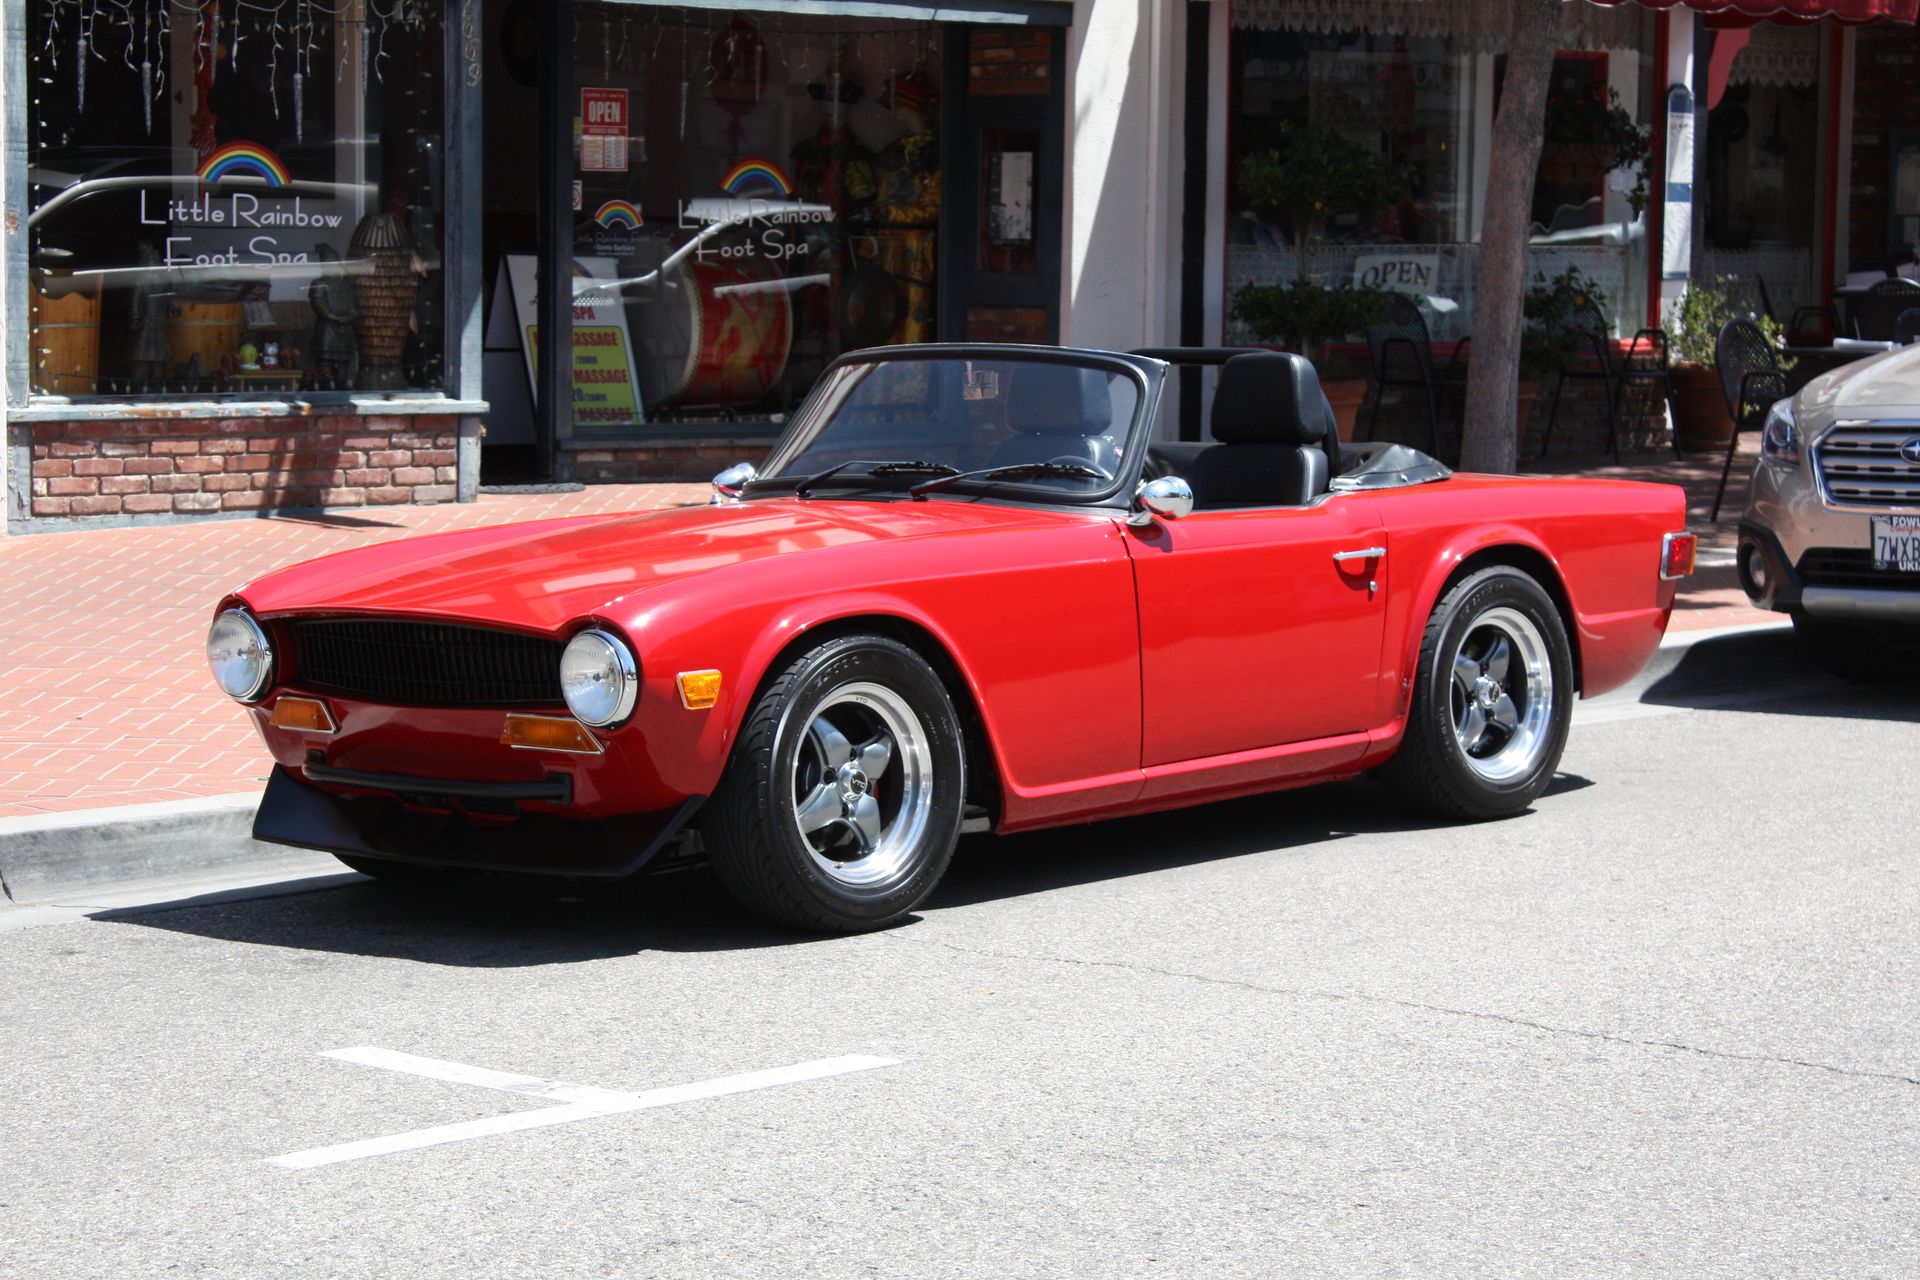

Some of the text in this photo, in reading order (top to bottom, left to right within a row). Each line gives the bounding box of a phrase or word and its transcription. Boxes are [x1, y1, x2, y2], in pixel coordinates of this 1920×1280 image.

[588, 101, 620, 122] OPEN
[141, 189, 343, 228] Little Rainbow
[678, 197, 837, 229] Little Rainbow
[163, 235, 309, 271] Foot Spa
[695, 229, 809, 262] Foot Spa
[1360, 261, 1432, 288] OPEN
[573, 305, 596, 321] SPA
[572, 331, 619, 347] ASSAGE
[573, 368, 629, 384] MASSAGE
[578, 406, 633, 422] MASSAGE
